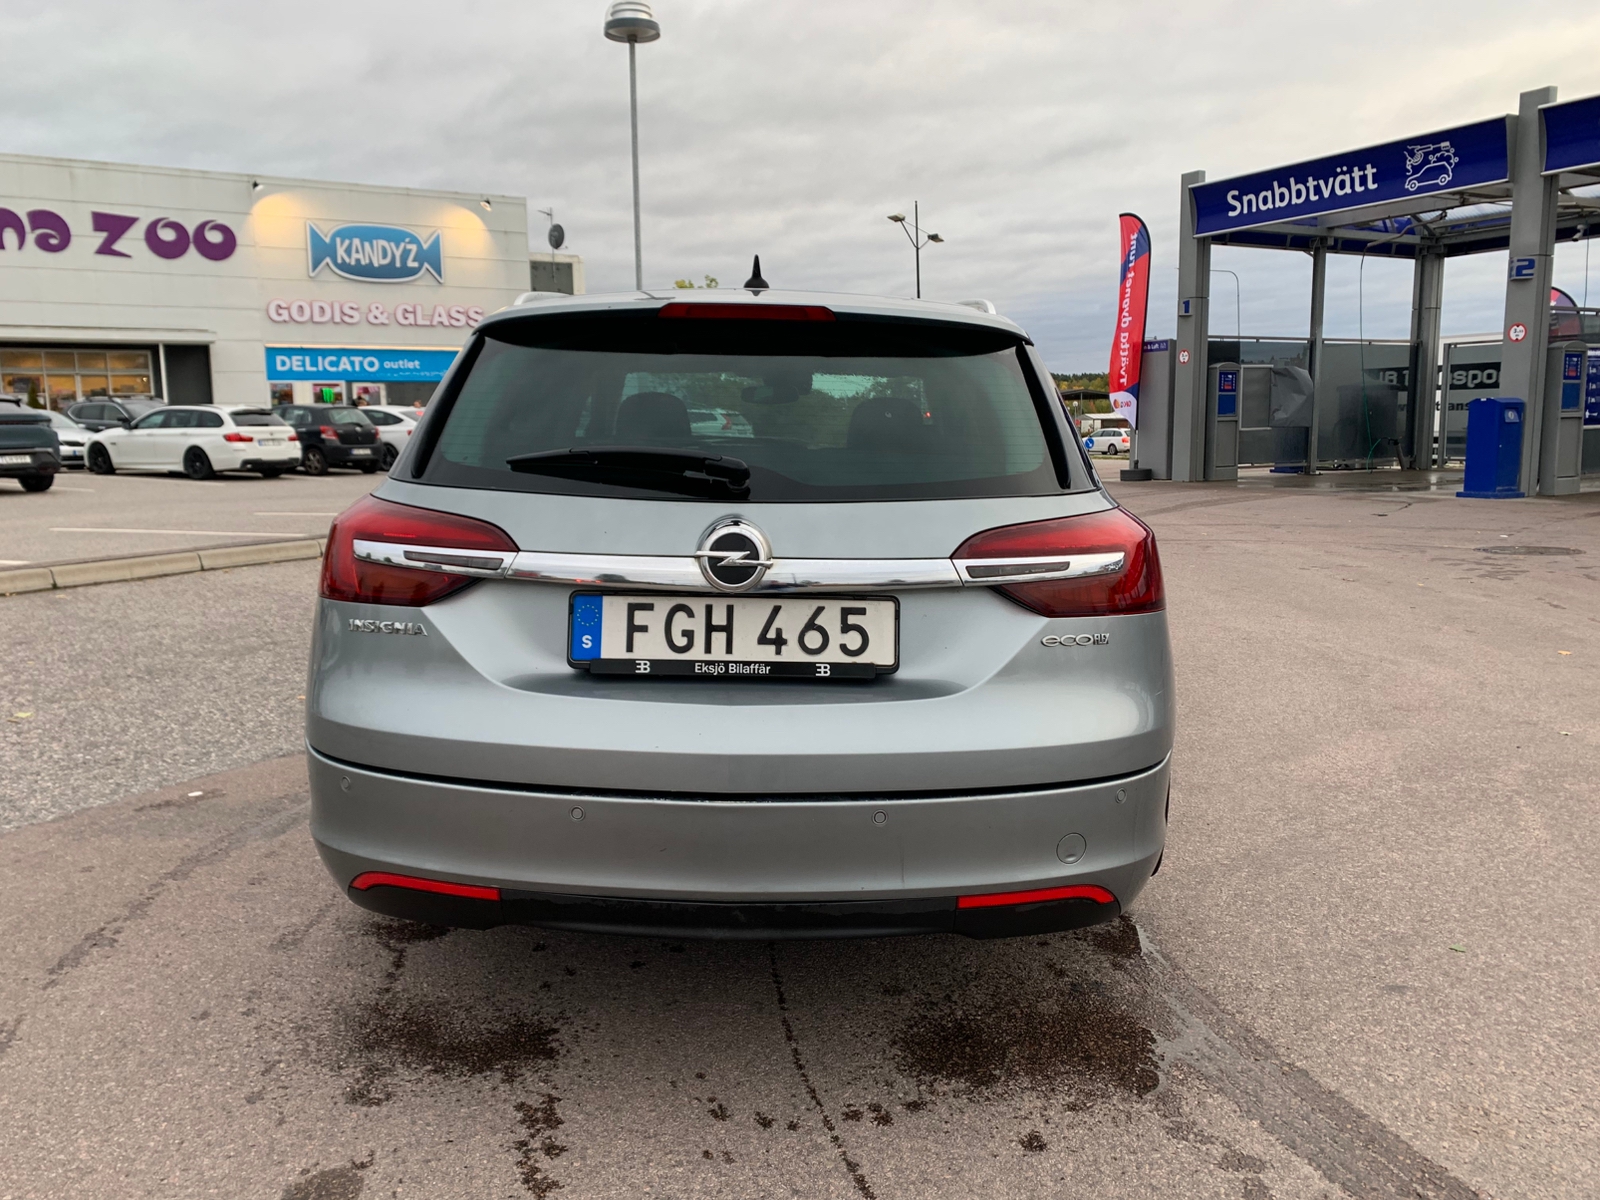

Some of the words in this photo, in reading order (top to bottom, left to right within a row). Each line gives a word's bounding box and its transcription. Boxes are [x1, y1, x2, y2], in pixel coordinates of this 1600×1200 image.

[1226, 163, 1379, 217] Snabbtvätt
[1515, 258, 1536, 277] 2
[267, 299, 361, 324] GODIS
[367, 302, 389, 325] &
[394, 303, 484, 328] GLASS
[1182, 300, 1190, 314] 1
[275, 355, 380, 373] DELICATO
[383, 359, 420, 370] outlet
[348, 618, 428, 637] INSIGNIA
[625, 602, 735, 655] FGH
[757, 605, 870, 657] 465
[581, 634, 593, 649] S
[694, 662, 725, 676] Eksjö
[728, 663, 771, 675] Bilaffär
